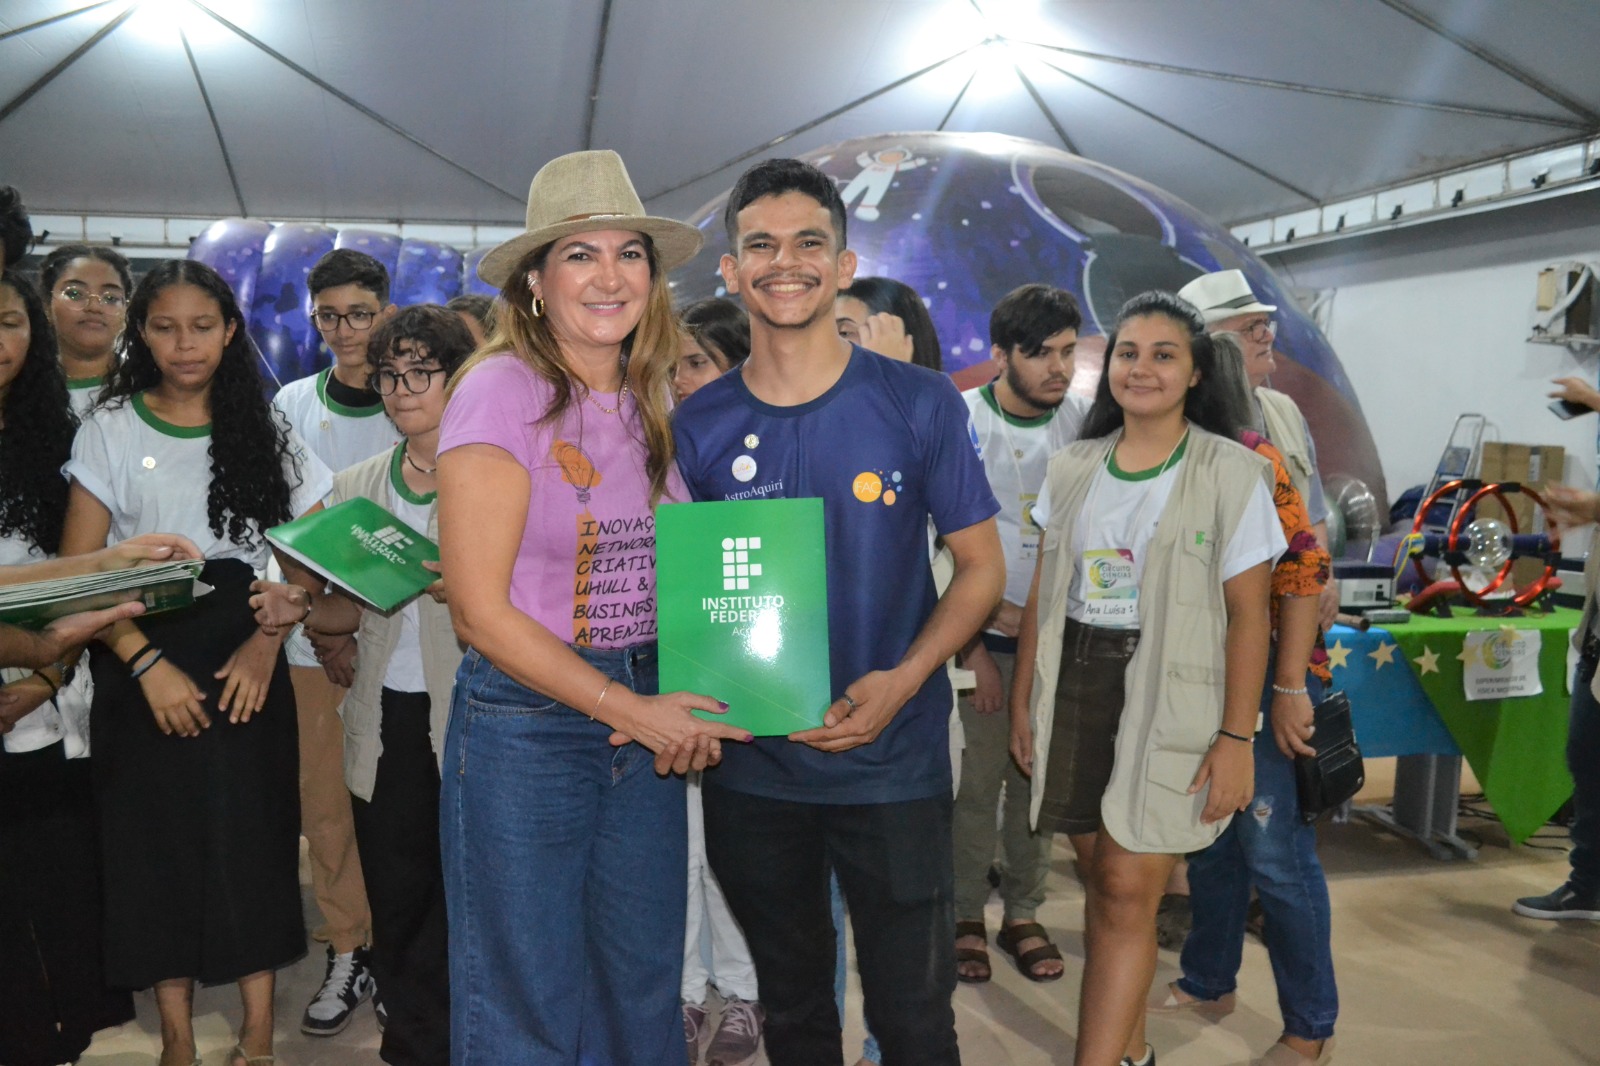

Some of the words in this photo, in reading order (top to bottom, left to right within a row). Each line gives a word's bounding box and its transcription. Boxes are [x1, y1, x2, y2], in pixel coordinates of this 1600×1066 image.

[724, 479, 784, 501] AstroAquiri
[580, 516, 656, 536] INOVAÇ
[575, 578, 630, 595] UHULL
[637, 576, 649, 592] &
[573, 598, 657, 619] BUSINES
[702, 595, 784, 610] INSTITUTO
[1085, 603, 1101, 615] Ana
